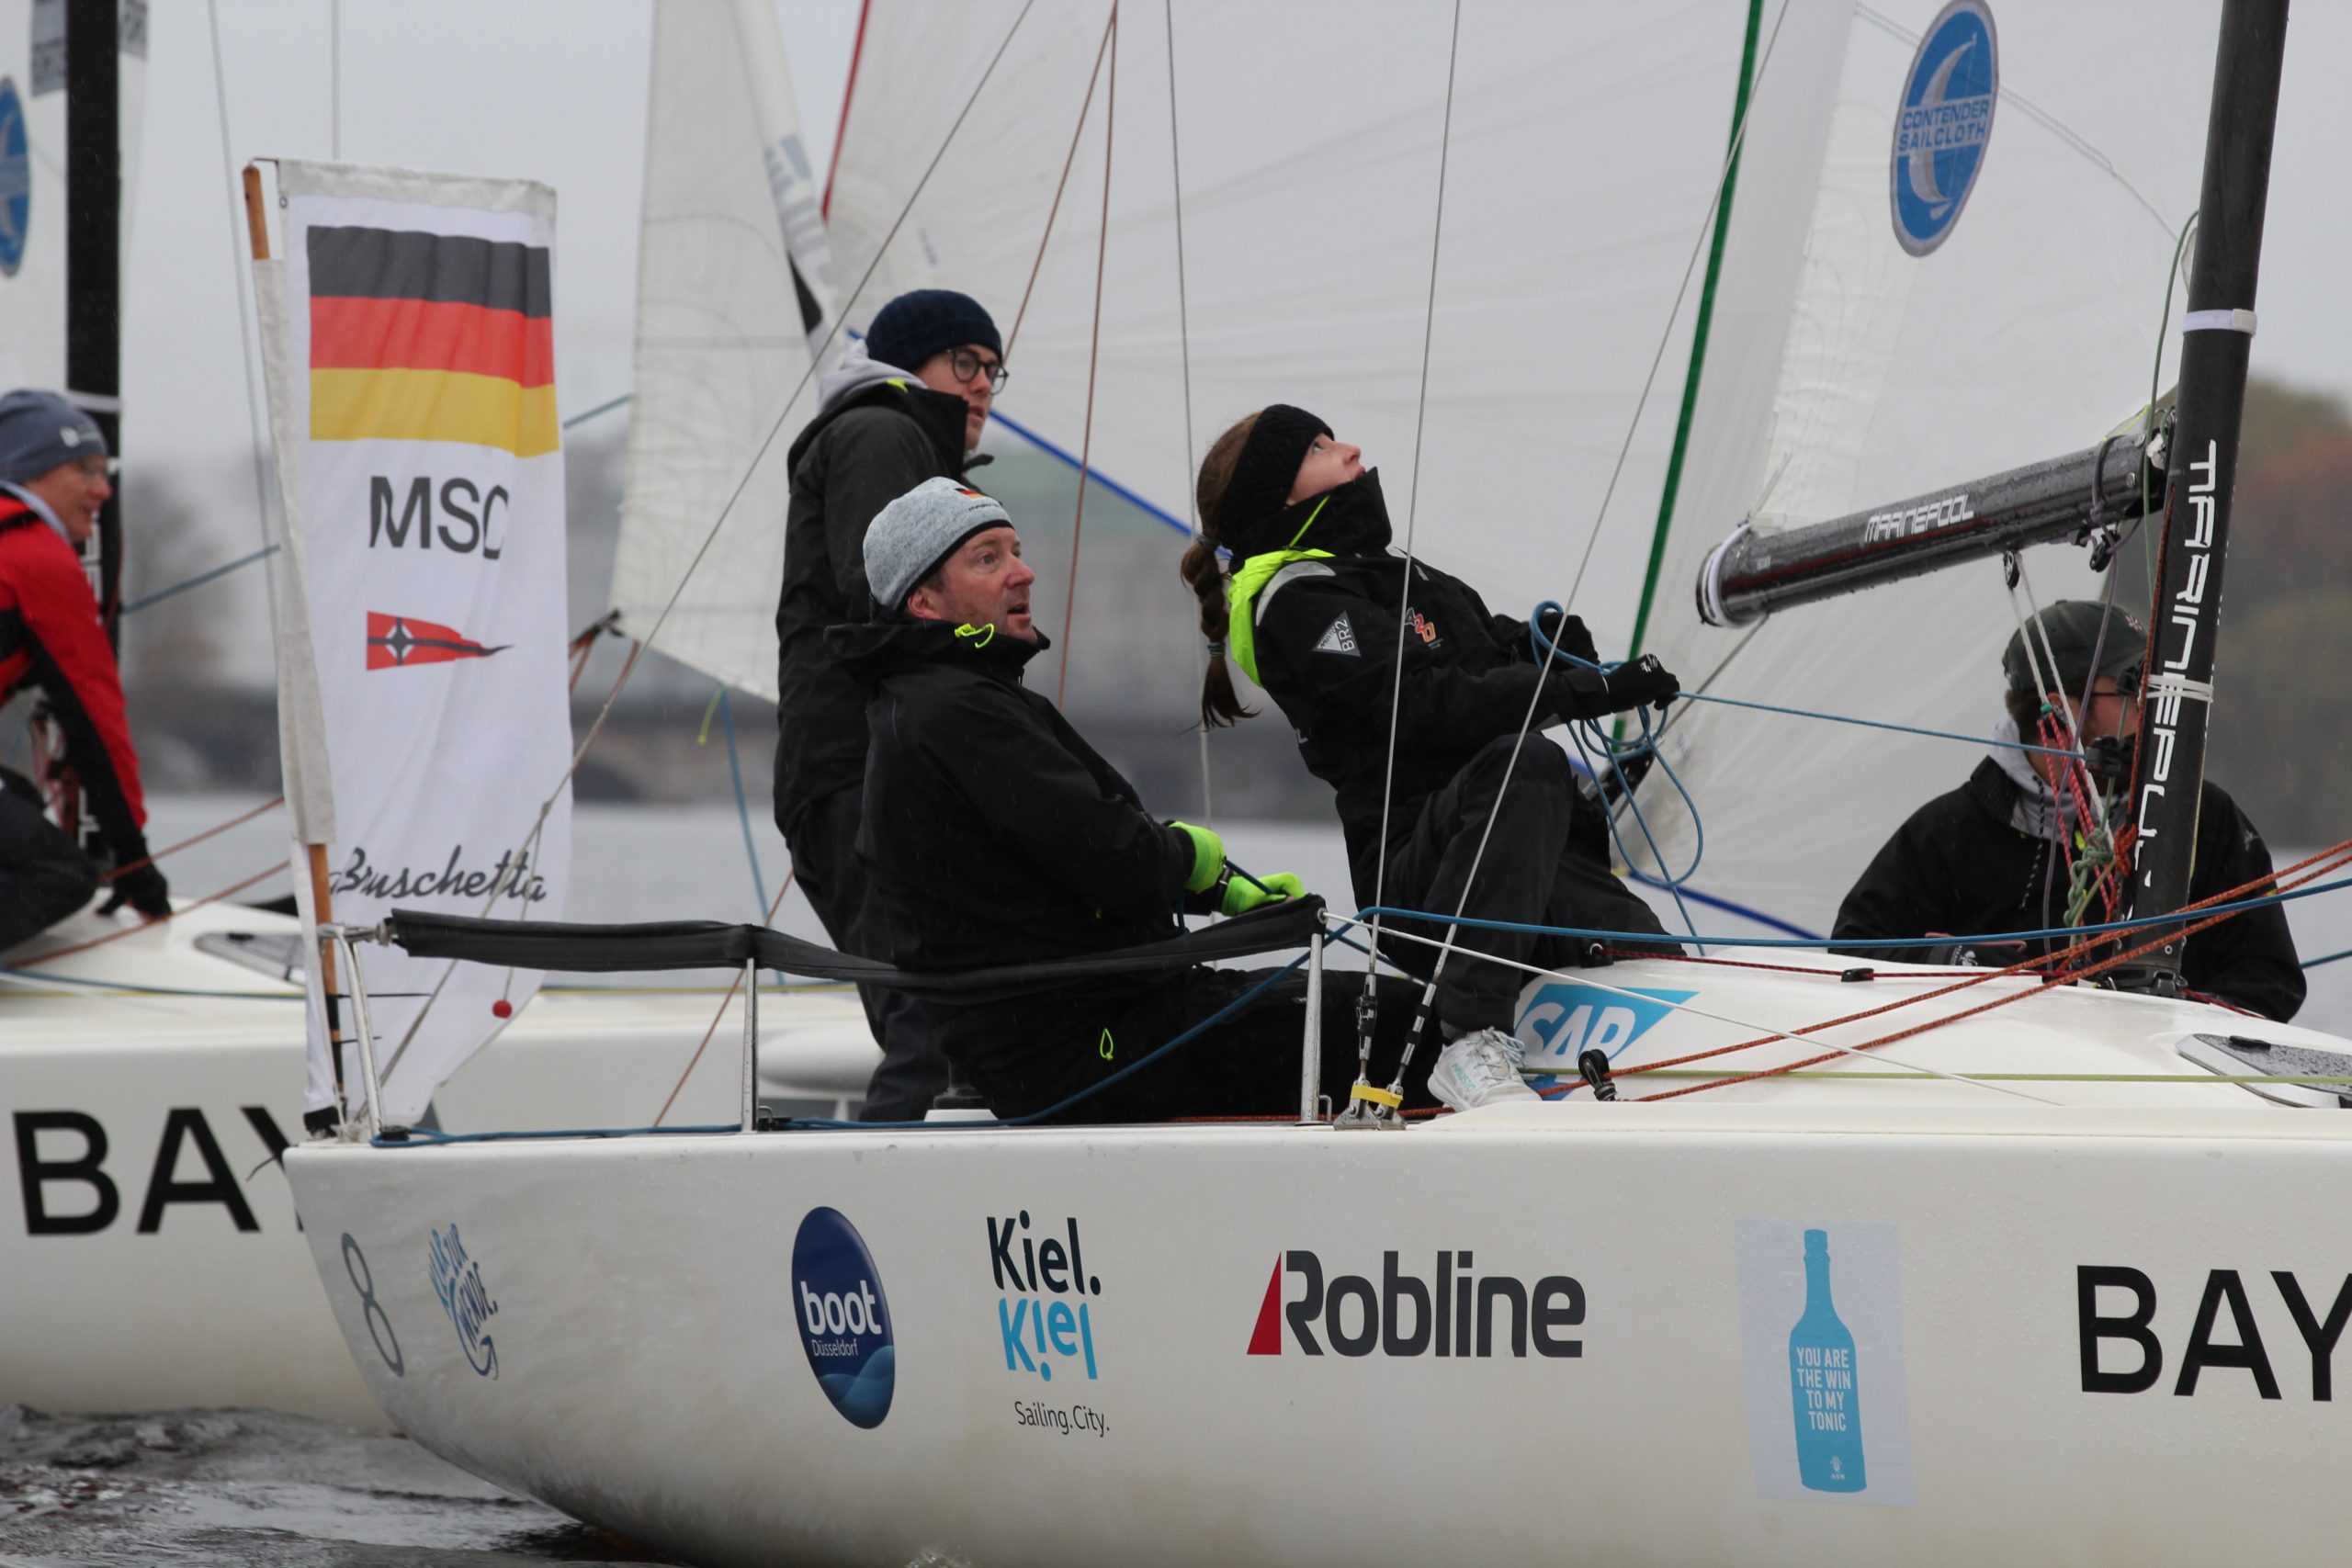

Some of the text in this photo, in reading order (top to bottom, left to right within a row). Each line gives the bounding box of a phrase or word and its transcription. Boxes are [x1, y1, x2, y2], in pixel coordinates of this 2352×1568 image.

[1902, 99, 1990, 130] CONTENDER
[1898, 121, 1986, 152] SAILCLOTH
[369, 476, 509, 560] MSC
[1864, 494, 1974, 543] MARINEPOOL
[1334, 618, 1355, 652] BR2
[1516, 1002, 1636, 1083] SAP
[987, 1210, 1102, 1296] Kiel.
[341, 1232, 405, 1378] 8
[800, 1280, 883, 1336] boot
[1247, 1250, 1587, 1359] Robline
[811, 1338, 859, 1358] Düsseldorf
[2077, 1265, 2352, 1402] BAY
[1796, 1347, 1849, 1369] YOU ARE
[1797, 1369, 1851, 1390] THE WIN
[1806, 1390, 1845, 1411] TO MY
[1808, 1411, 1847, 1431] TONIC
